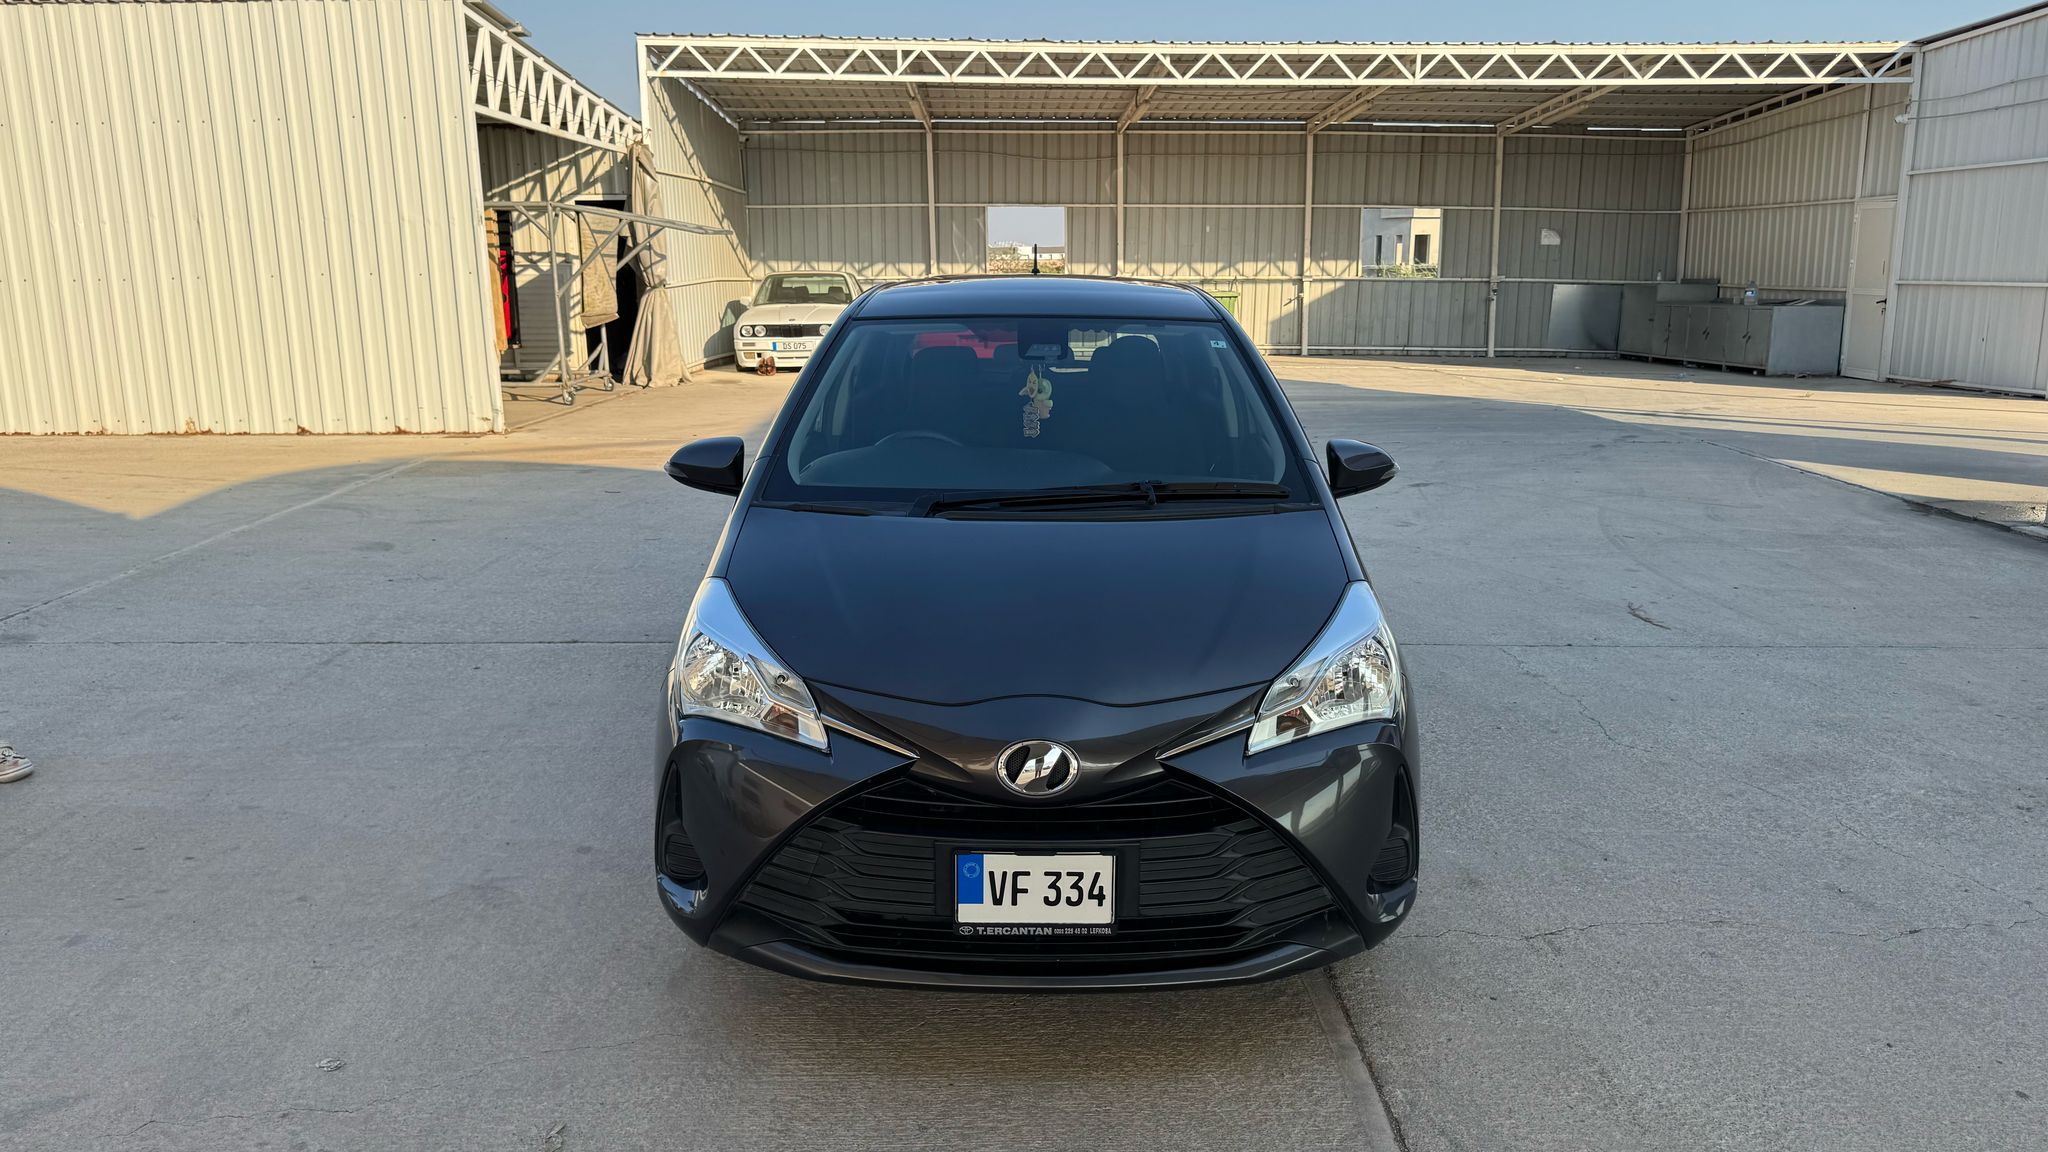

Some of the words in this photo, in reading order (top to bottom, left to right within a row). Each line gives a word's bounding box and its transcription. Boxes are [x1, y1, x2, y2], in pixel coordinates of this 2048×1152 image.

[988, 870, 1031, 906] VF
[1043, 871, 1106, 907] 334
[976, 926, 1052, 936] T.ERCANTAN
